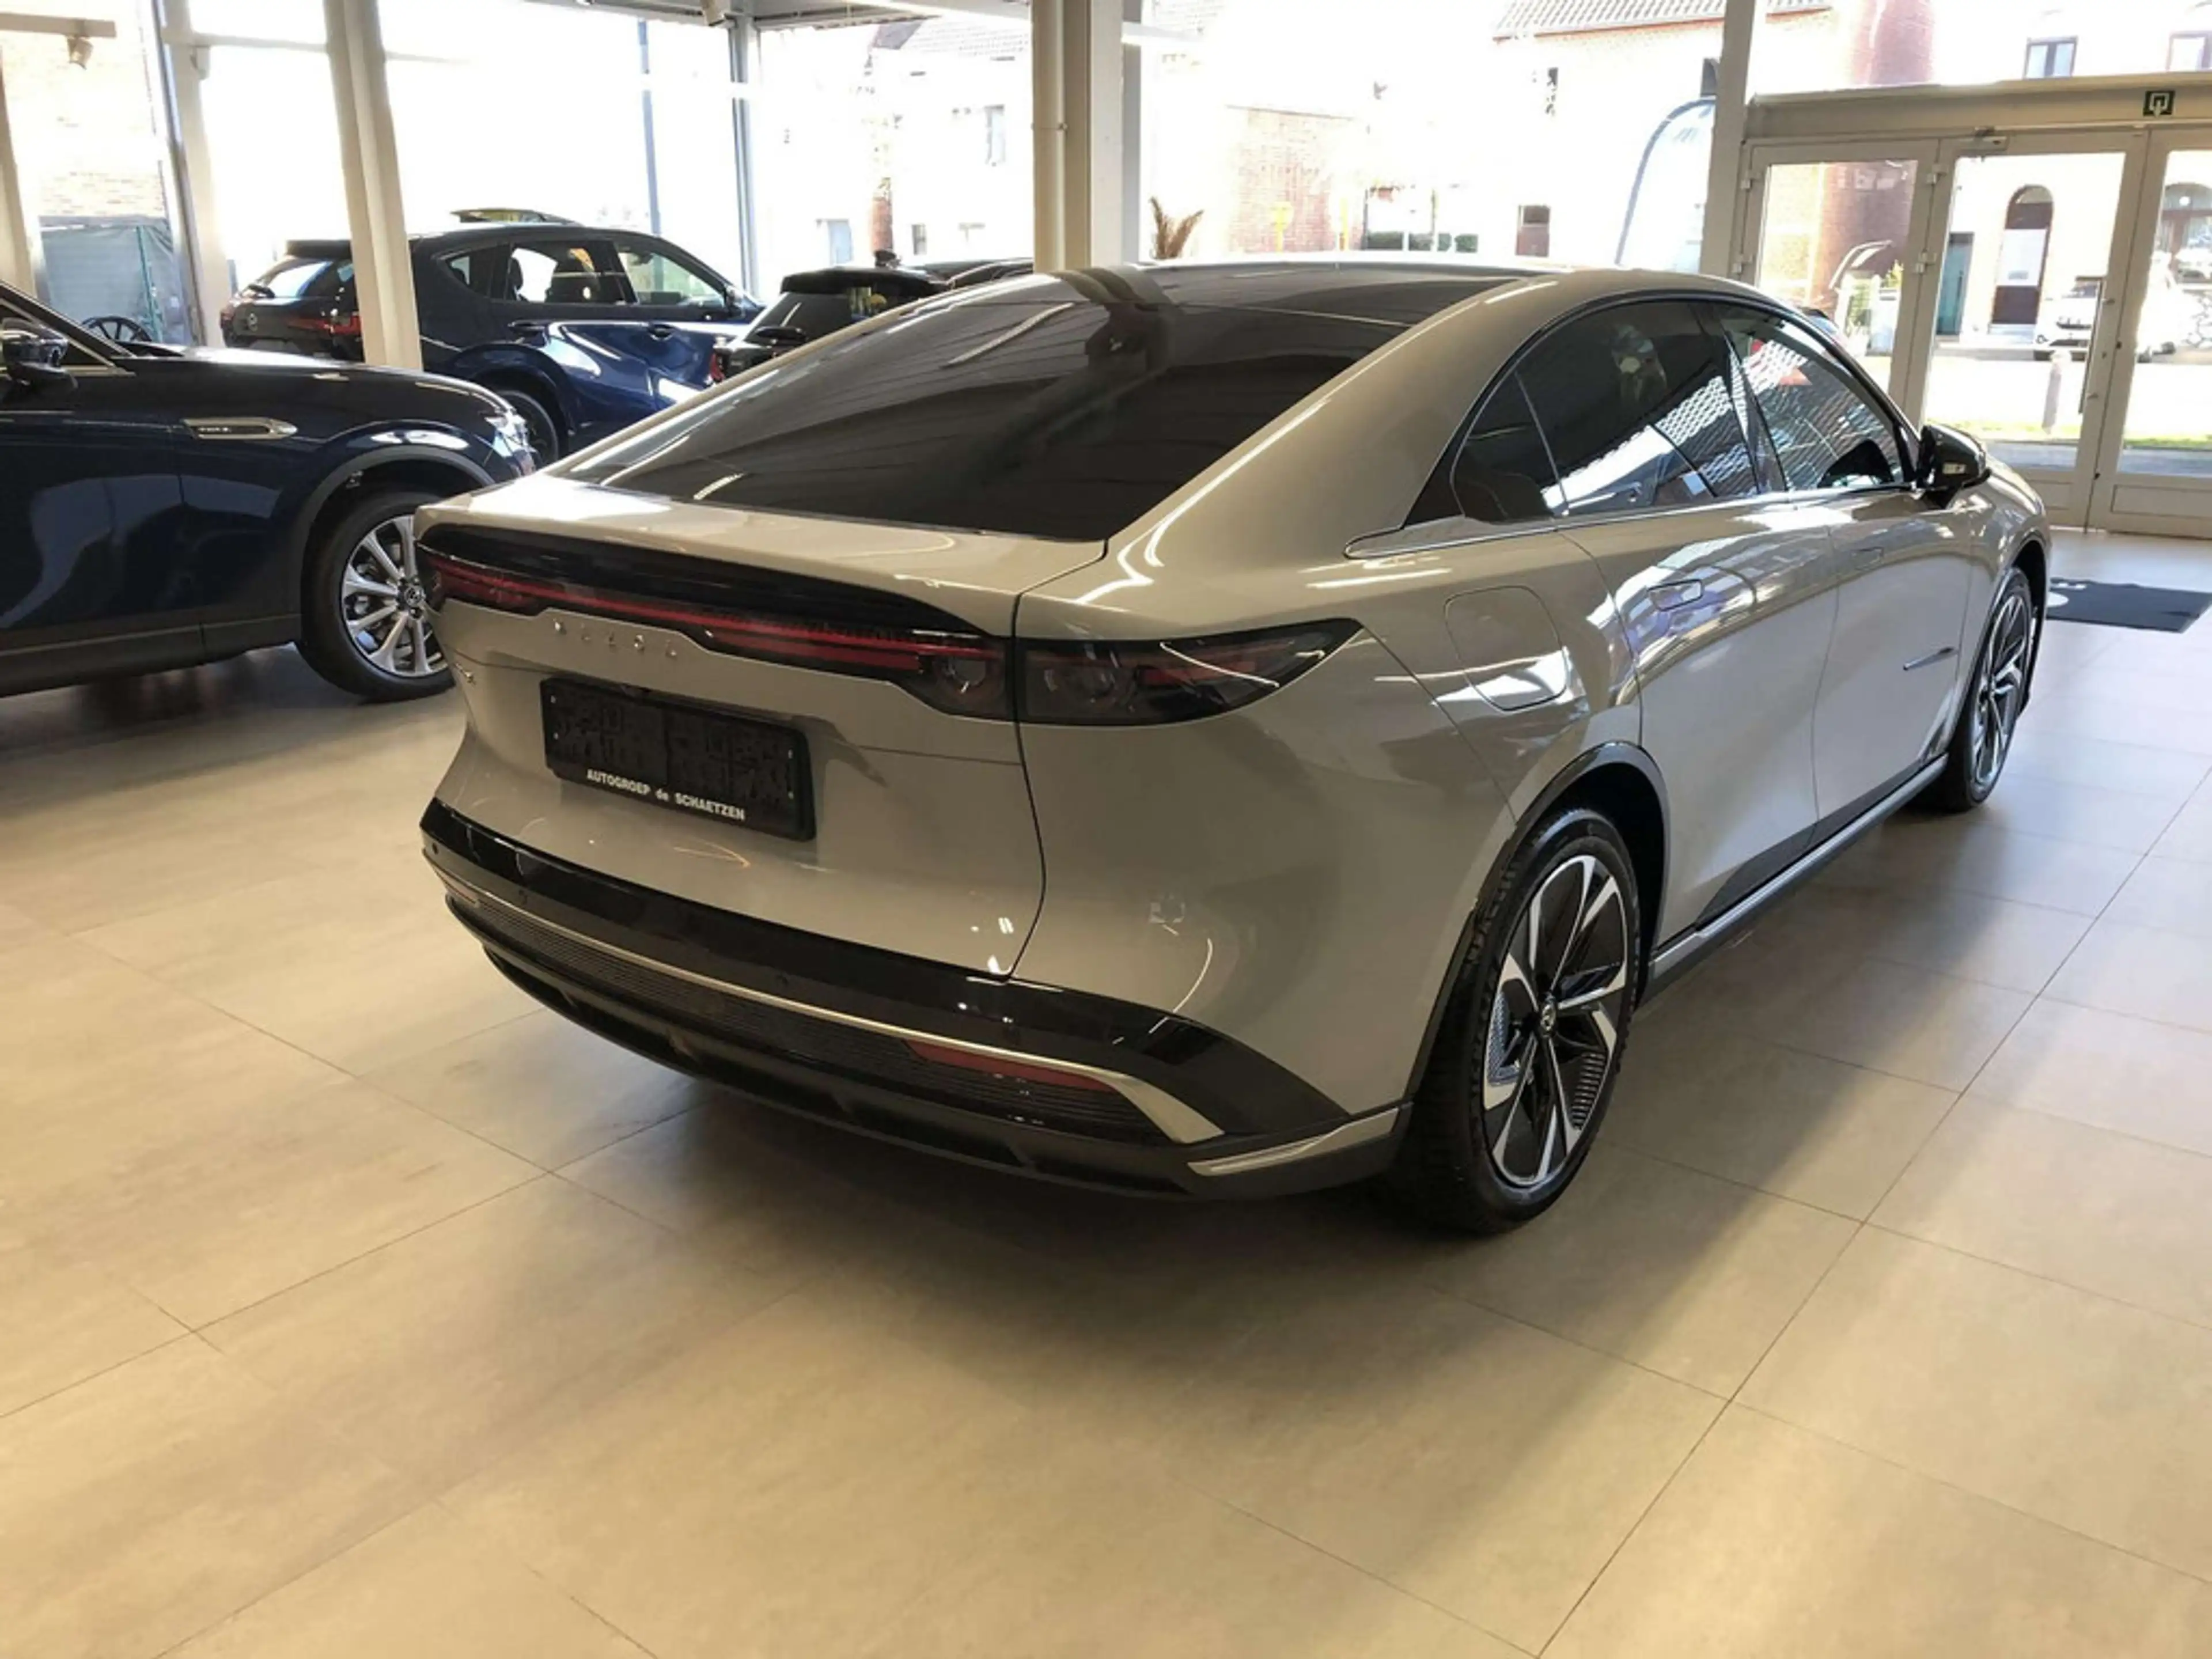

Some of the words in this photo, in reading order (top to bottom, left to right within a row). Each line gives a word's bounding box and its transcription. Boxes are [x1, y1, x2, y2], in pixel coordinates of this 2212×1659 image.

[587, 768, 651, 795] AUTOGROEP
[655, 787, 669, 801] de
[675, 792, 745, 821] SCHAETZEN
